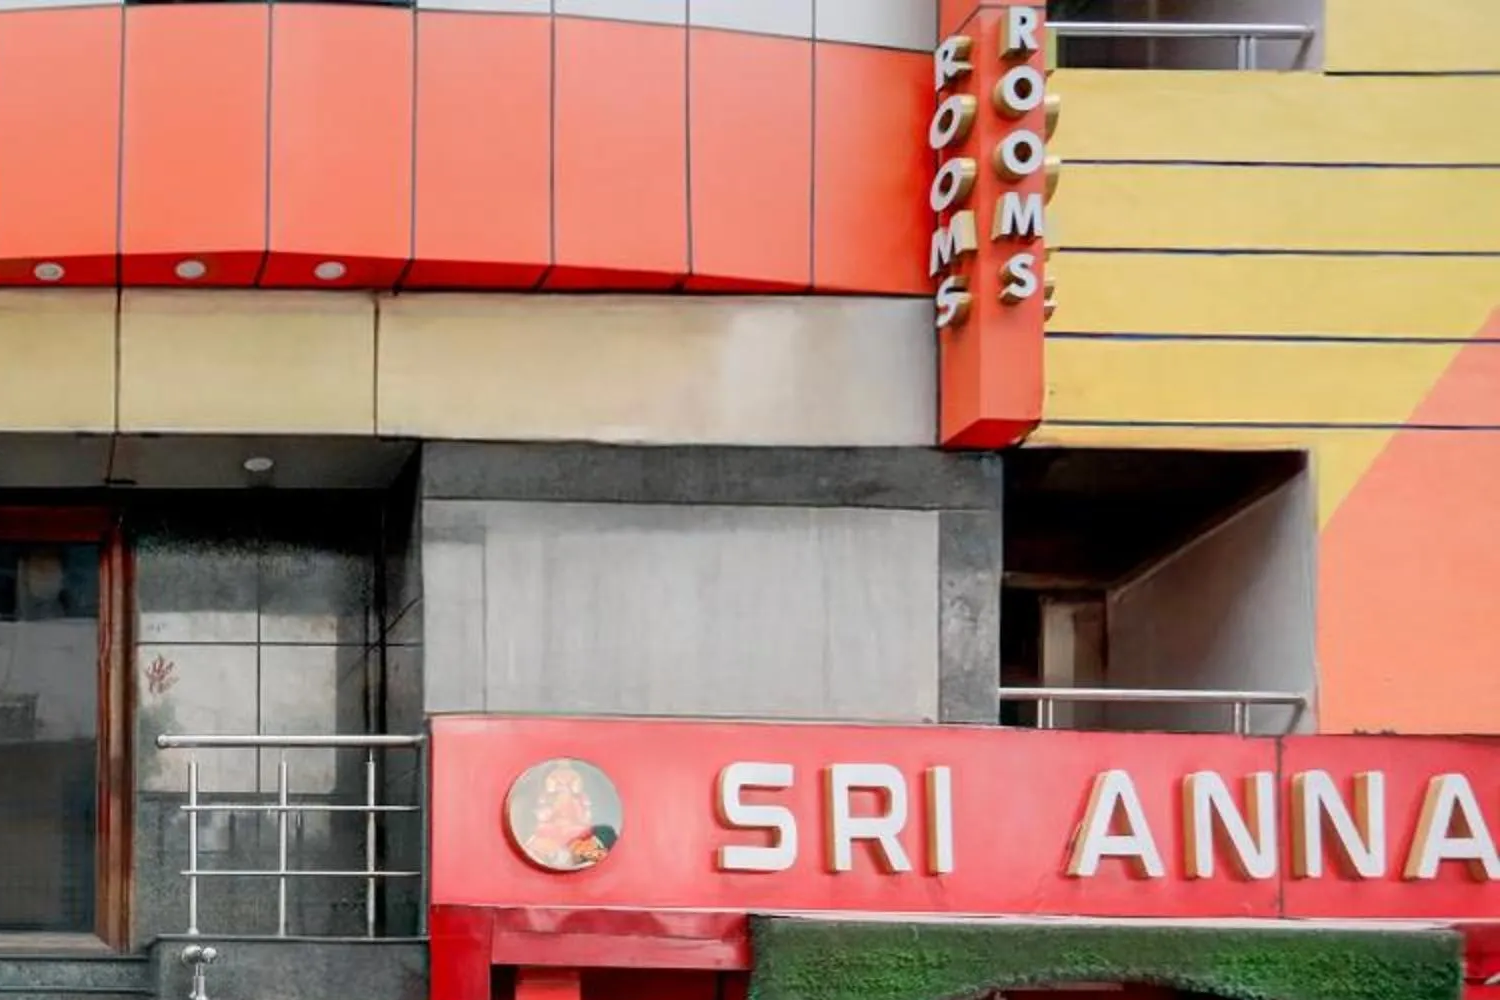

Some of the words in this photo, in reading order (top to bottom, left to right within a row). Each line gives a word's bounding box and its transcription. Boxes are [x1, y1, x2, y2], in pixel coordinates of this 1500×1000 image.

[930, 36, 976, 327] ROOMS
[993, 7, 1043, 302] ROOMS
[717, 762, 953, 873] SRI
[1067, 769, 1500, 880] ANNA
